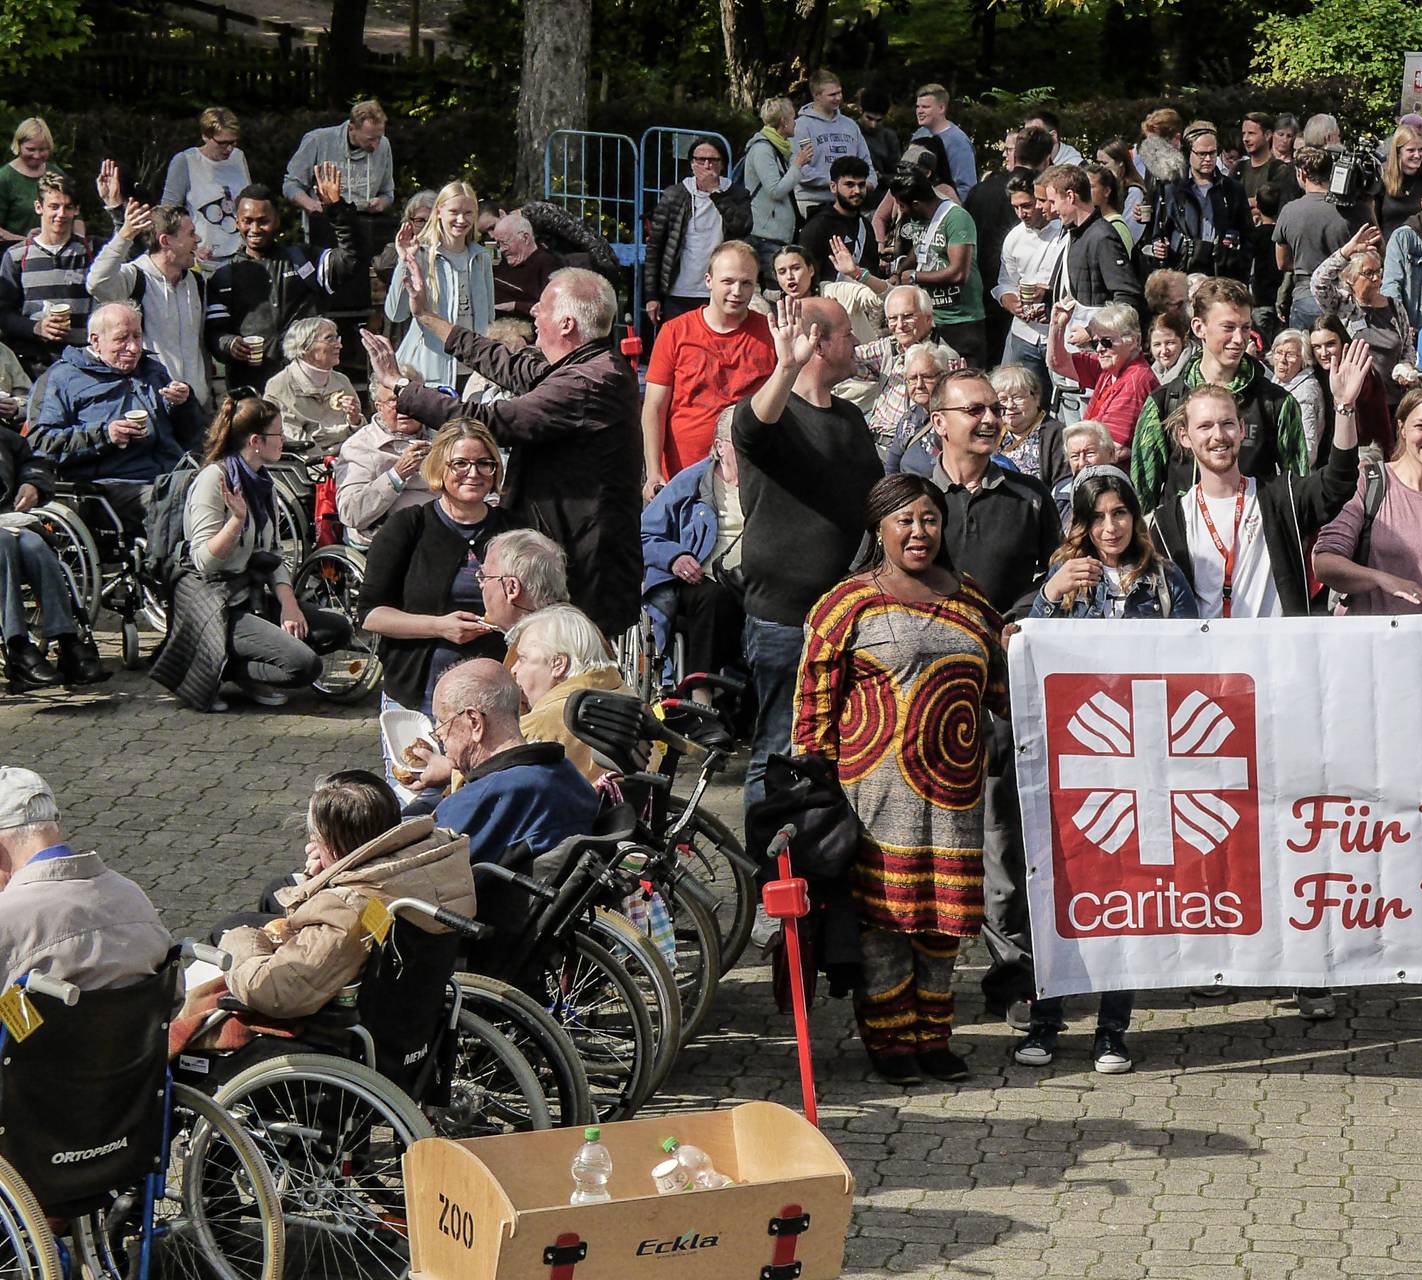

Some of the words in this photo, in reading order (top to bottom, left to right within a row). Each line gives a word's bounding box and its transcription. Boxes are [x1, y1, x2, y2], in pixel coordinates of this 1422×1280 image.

[1287, 795, 1411, 853] Für
[1068, 877, 1243, 932] caritas
[1289, 873, 1412, 931] Für
[51, 1136, 128, 1165] ORTOPEDIA
[439, 1192, 474, 1249] ZOO
[635, 1233, 719, 1257] Eckla
